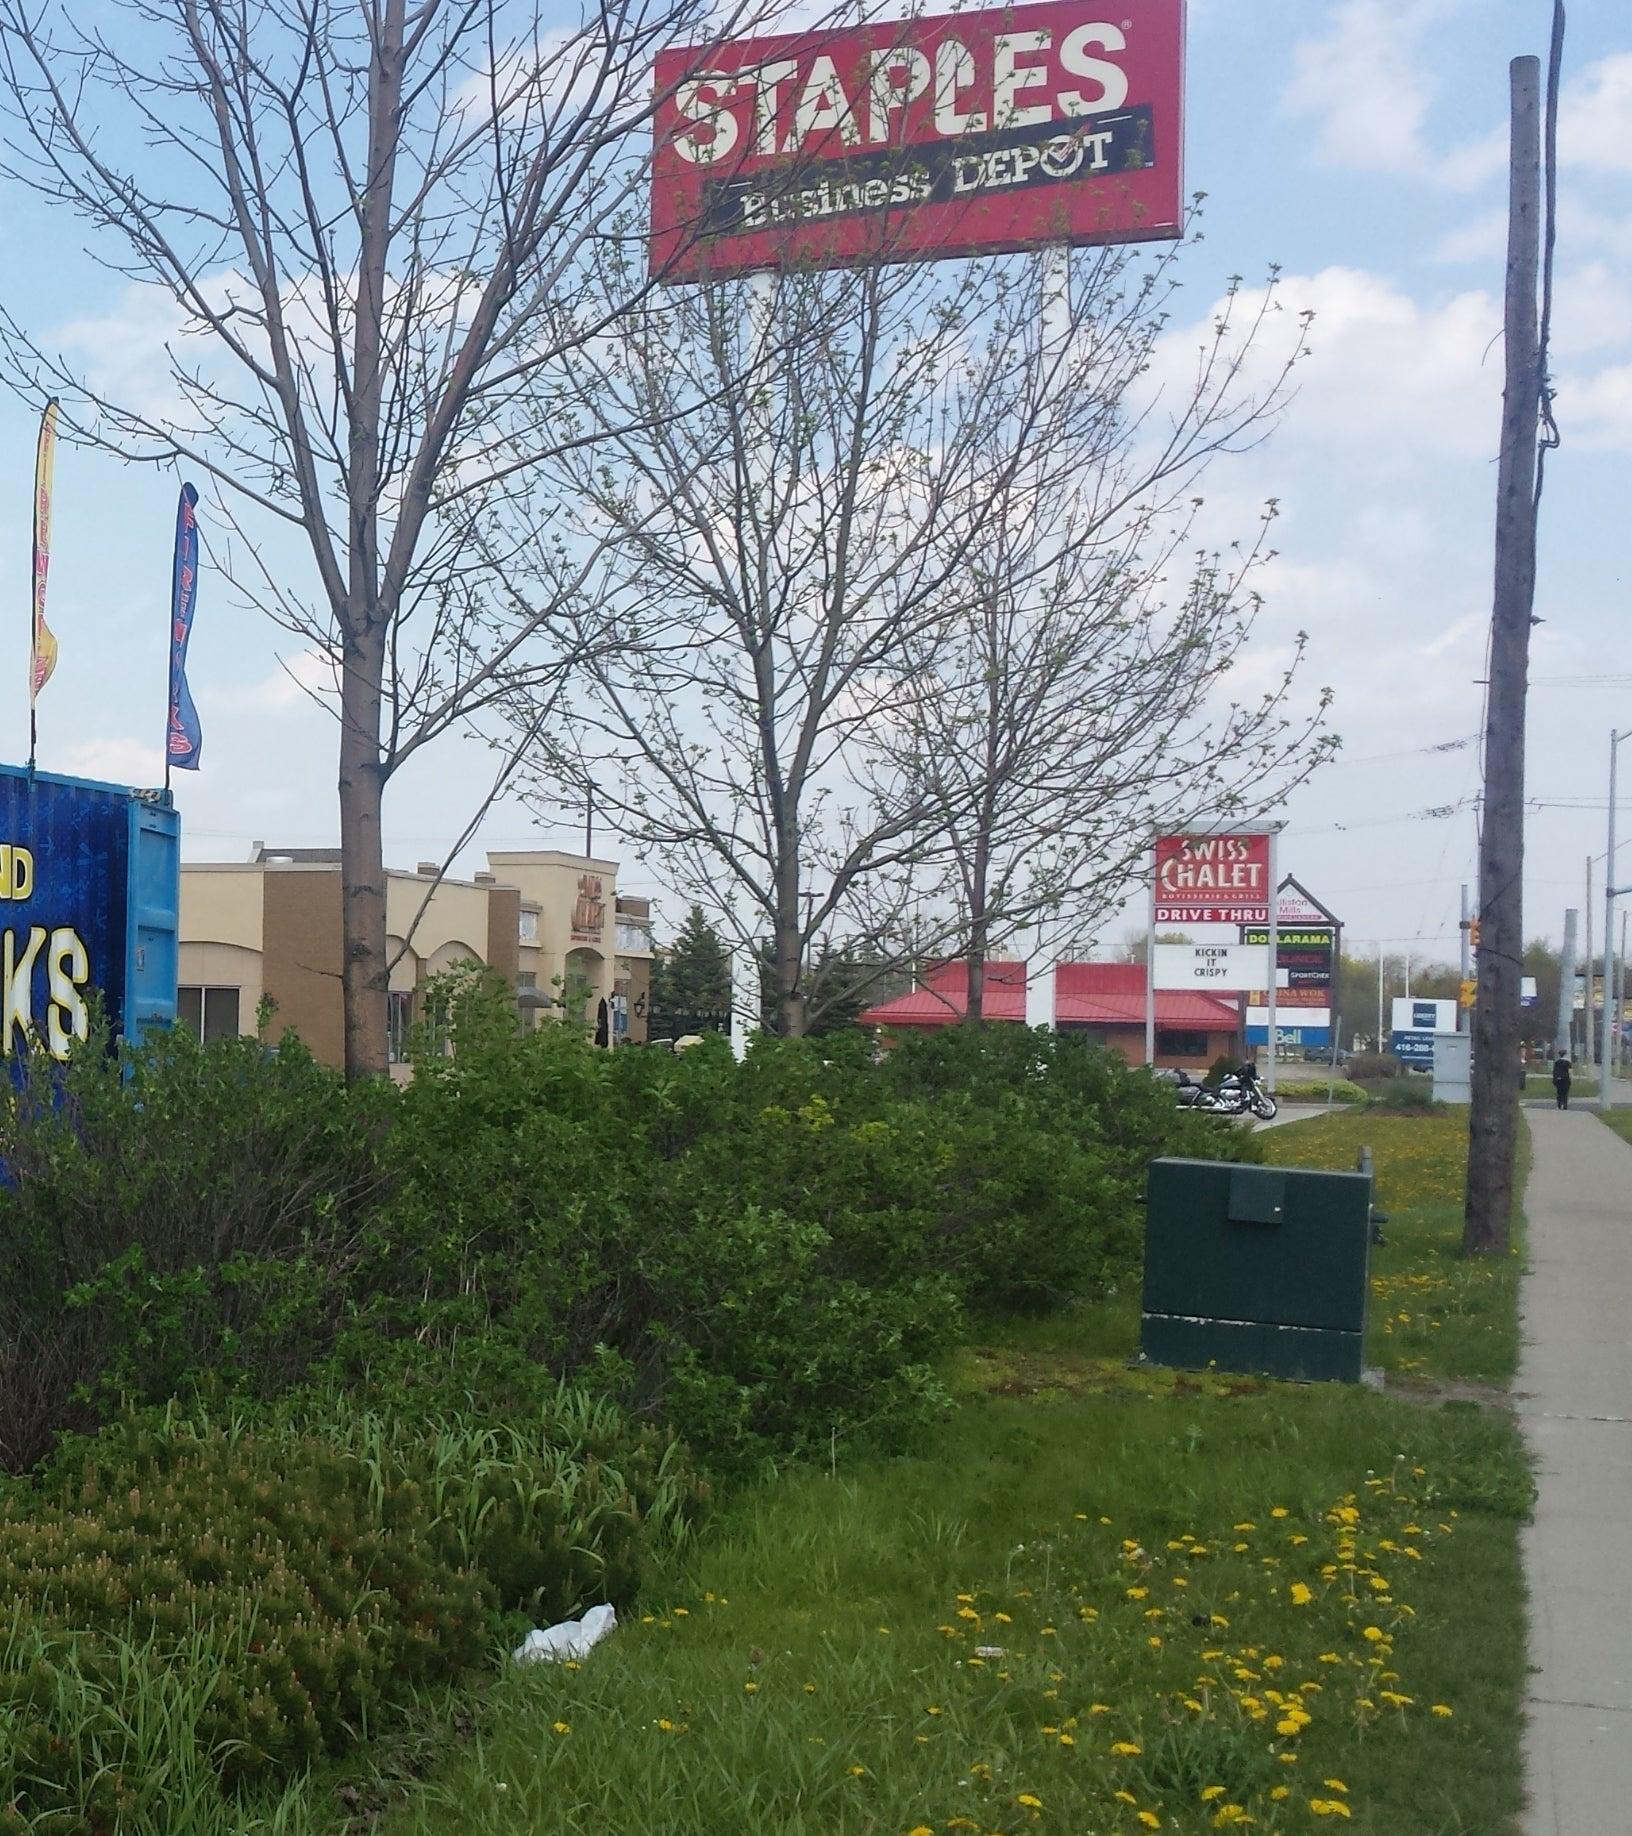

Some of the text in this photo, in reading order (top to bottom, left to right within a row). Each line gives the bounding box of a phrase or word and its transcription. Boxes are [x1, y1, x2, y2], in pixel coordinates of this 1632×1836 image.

[673, 22, 1130, 165] STAPLES
[739, 131, 1113, 229] Business DEPOT
[1181, 839, 1248, 861] SWISS
[1160, 857, 1264, 892] CHALET
[1156, 909, 1212, 921] DRIVE
[1218, 909, 1267, 921] THRU
[1249, 934, 1330, 944] DOLARAMA
[1195, 948, 1228, 957] KICKIN
[1207, 958, 1217, 967] IT
[1194, 968, 1228, 977] CRISPY
[1263, 989, 1325, 997] CINA WOK
[1275, 1029, 1302, 1044] Bell
